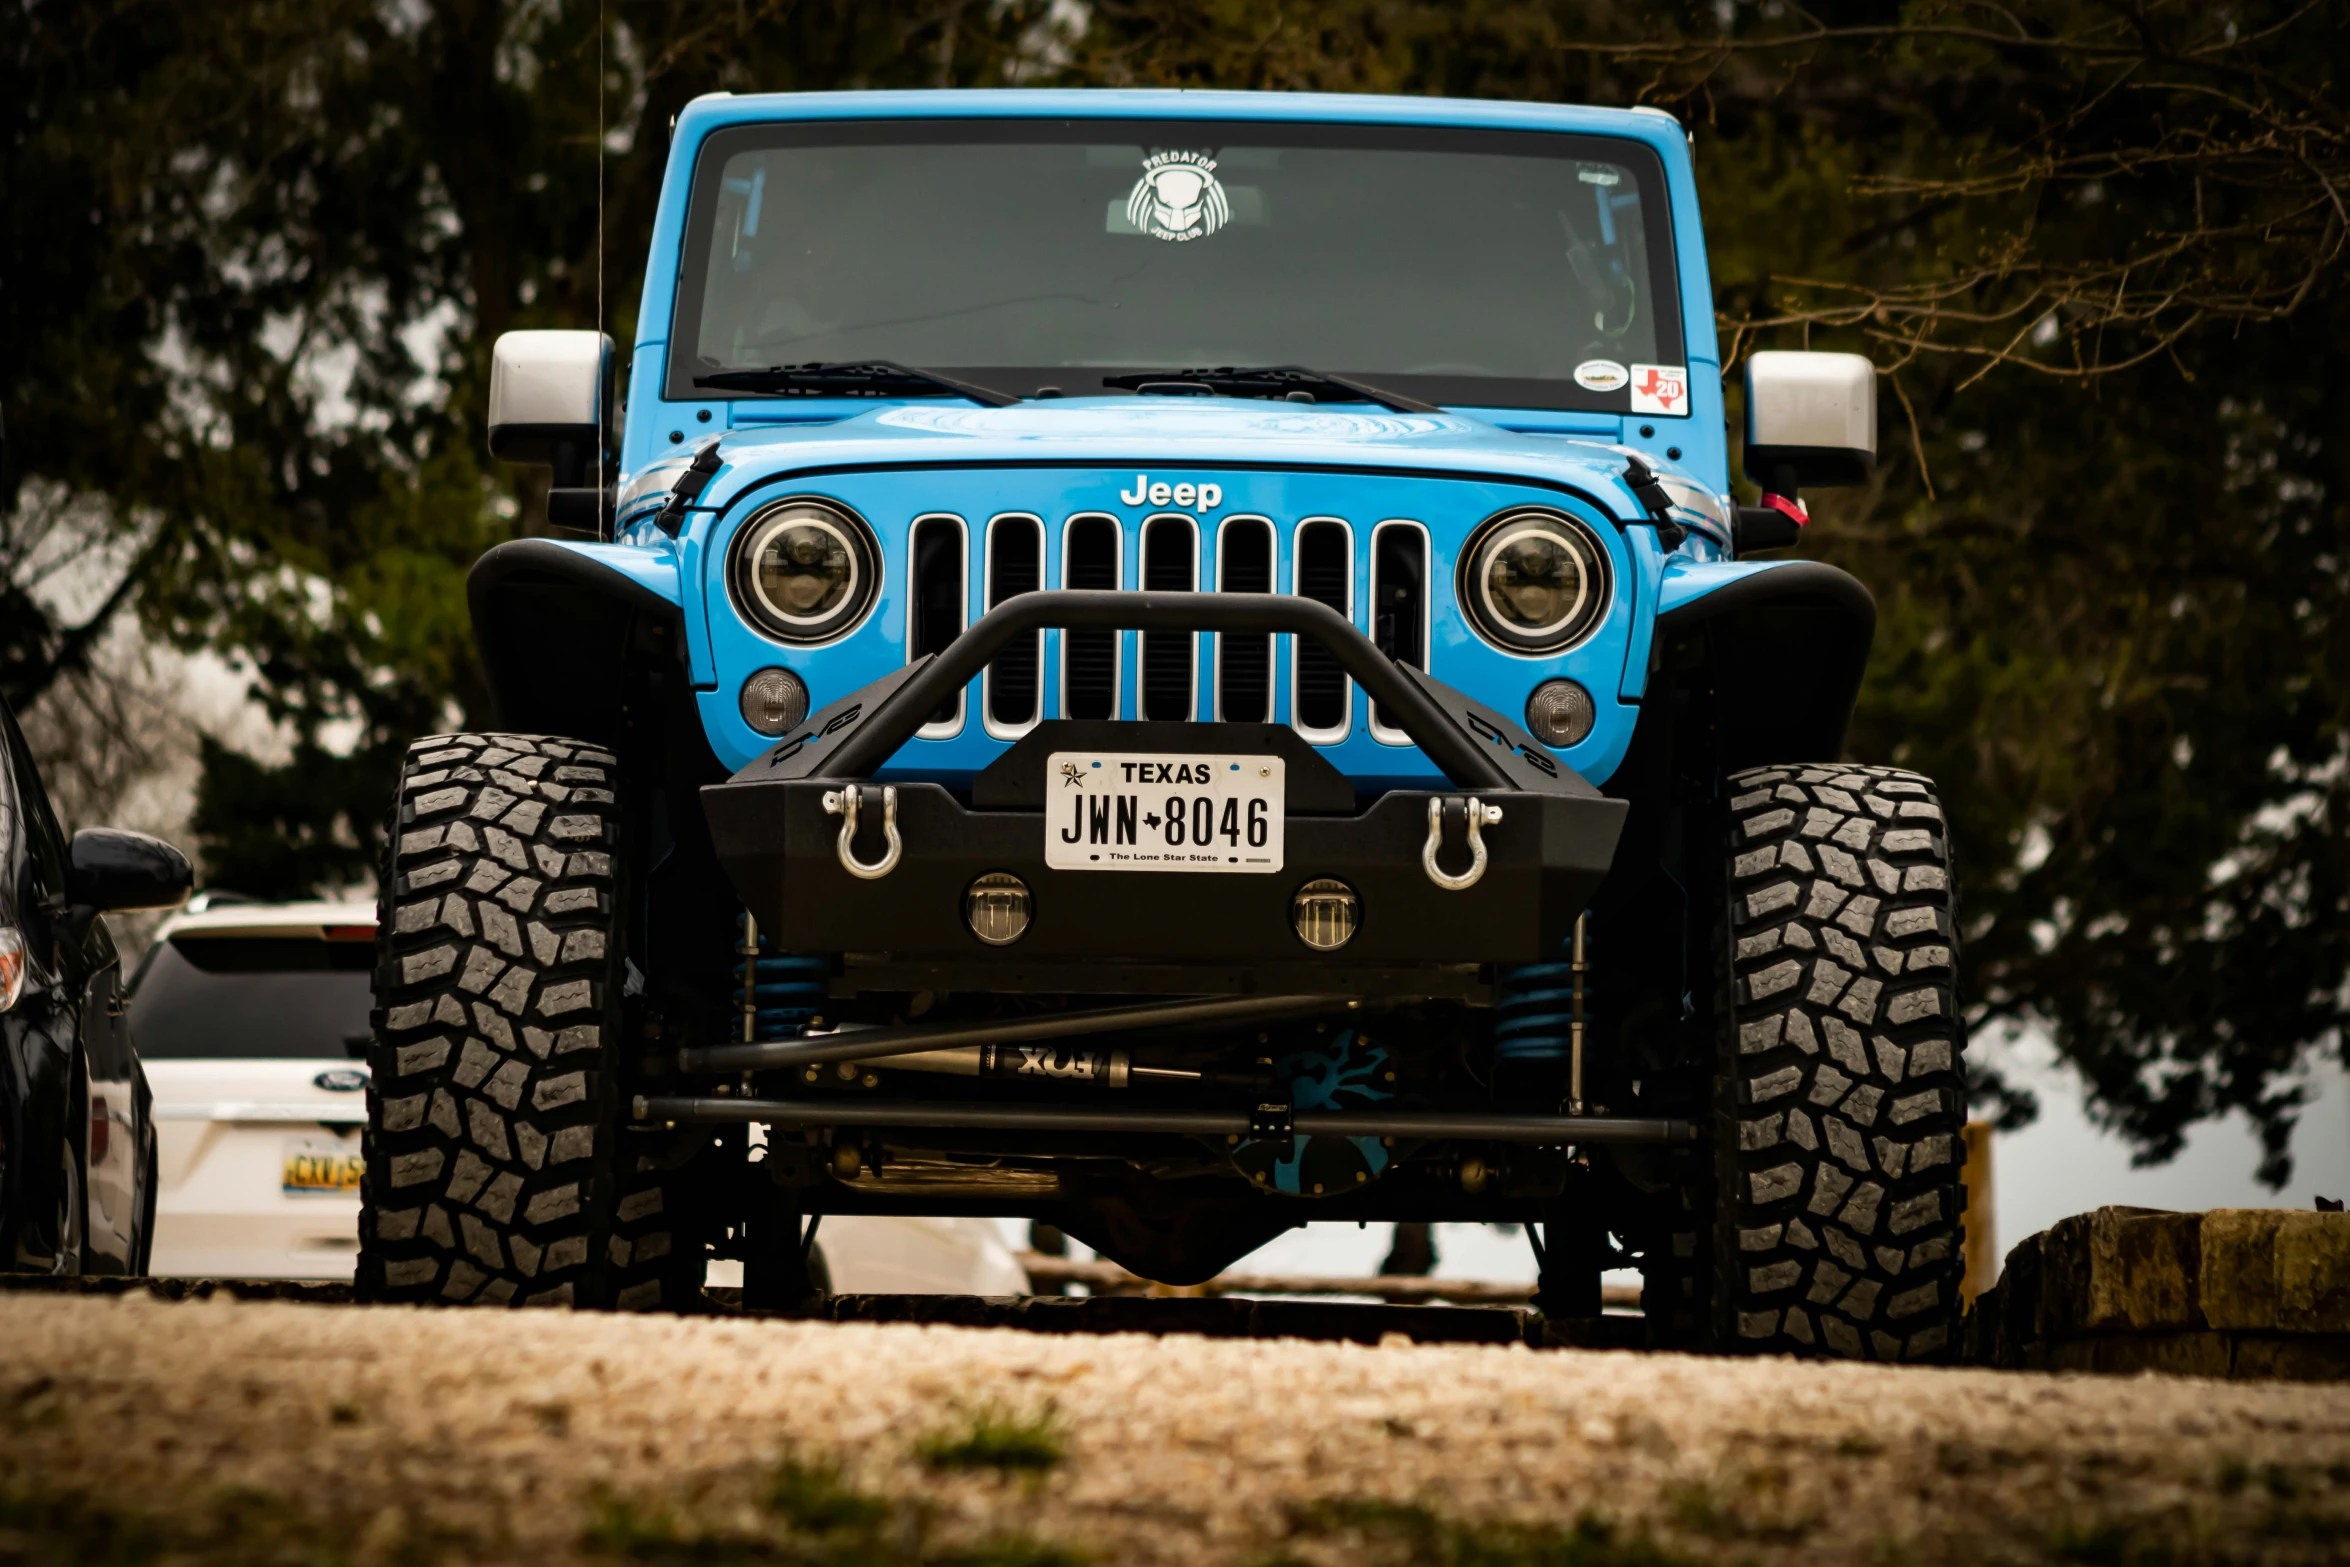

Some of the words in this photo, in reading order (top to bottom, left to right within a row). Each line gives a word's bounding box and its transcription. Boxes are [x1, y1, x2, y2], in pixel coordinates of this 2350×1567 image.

[1142, 151, 1217, 172] PREDATOR
[1151, 227, 1176, 241] JEEP
[1177, 227, 1203, 241] CLUB
[1655, 380, 1679, 399] 20
[1120, 474, 1222, 513] Jeep
[1121, 763, 1211, 785] TEXAS
[1110, 852, 1131, 861] The
[1133, 853, 1161, 861] Lone
[1164, 854, 1186, 862] Star
[1189, 854, 1218, 862] State
[1018, 1046, 1095, 1080] FOX
